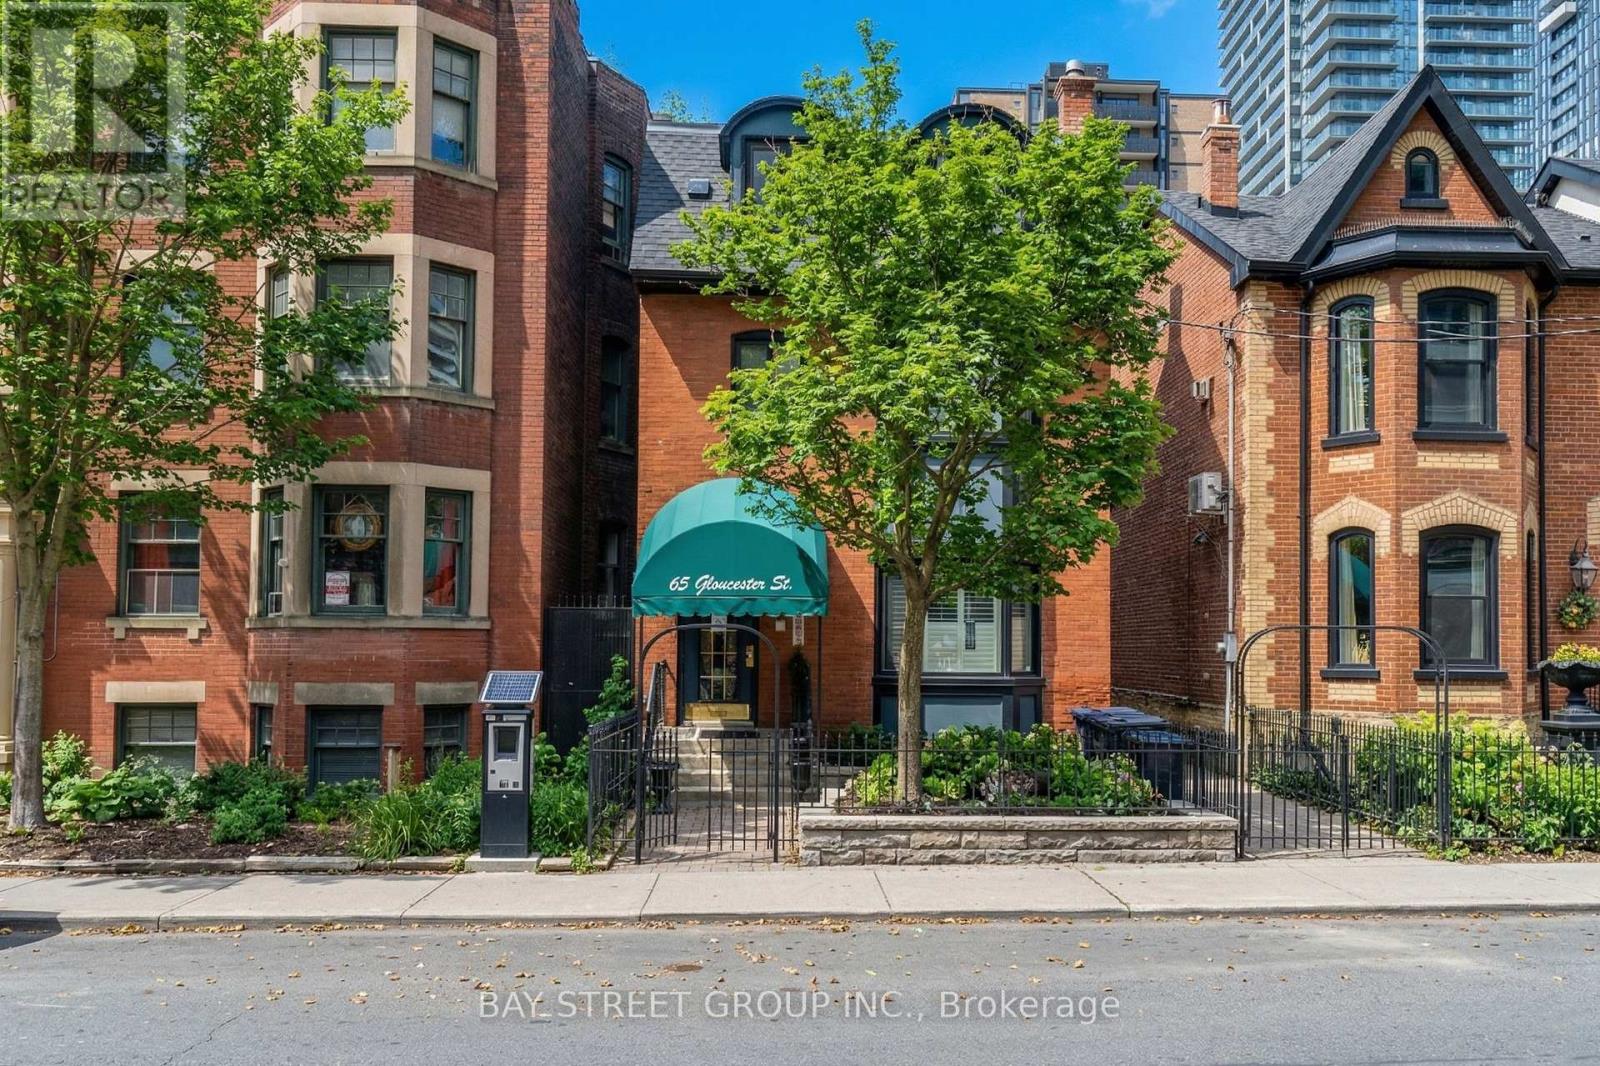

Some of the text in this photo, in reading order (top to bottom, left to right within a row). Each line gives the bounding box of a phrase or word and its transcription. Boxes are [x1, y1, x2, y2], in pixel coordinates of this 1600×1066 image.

[669, 574, 792, 596] 65 Gloucester St.
